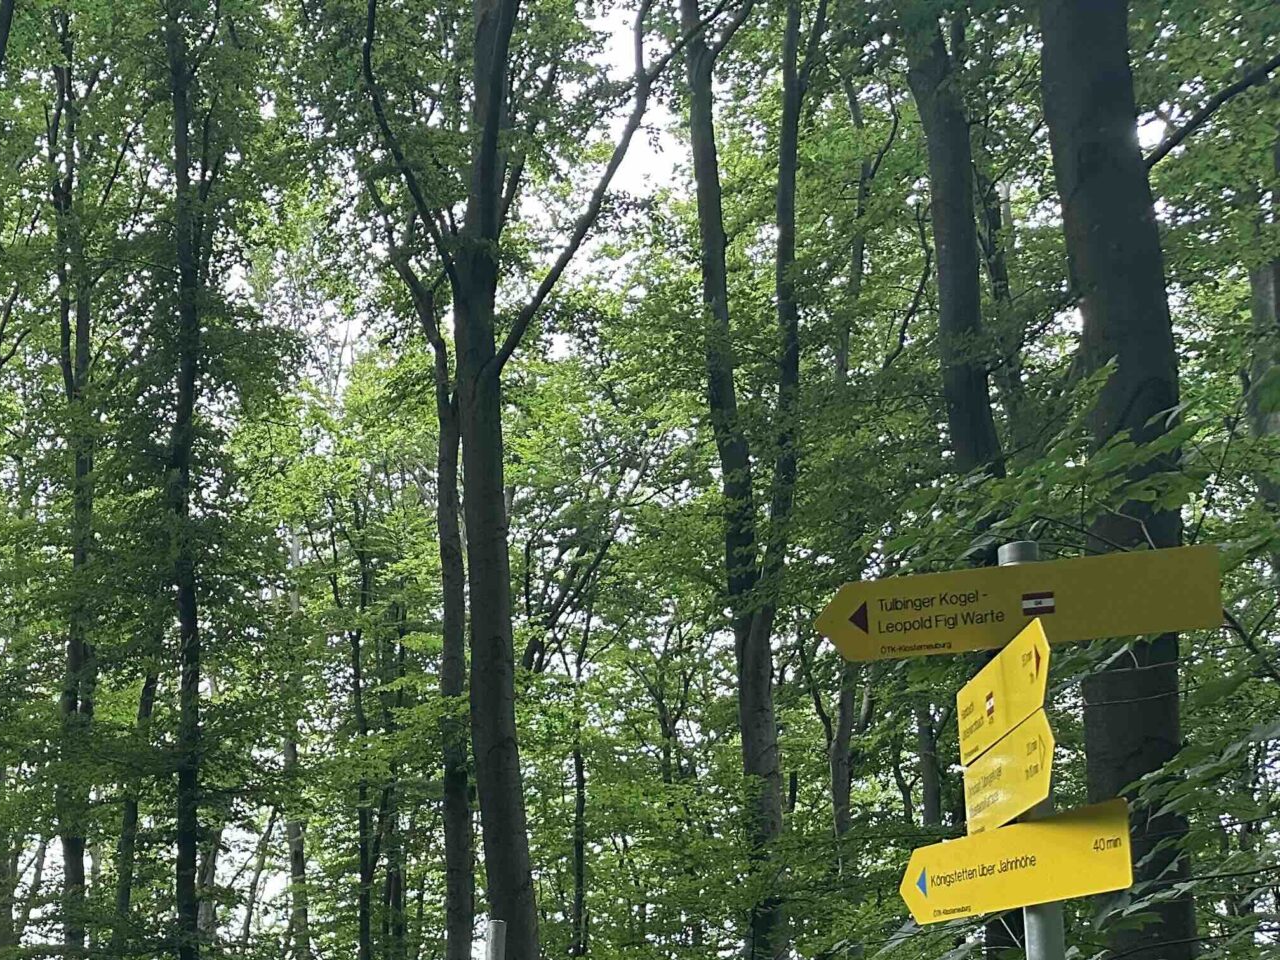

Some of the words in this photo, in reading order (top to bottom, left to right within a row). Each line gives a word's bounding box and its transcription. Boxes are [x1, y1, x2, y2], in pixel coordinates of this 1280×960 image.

[878, 595, 935, 611] Tulbinger
[939, 590, 979, 606] Kogel
[878, 616, 932, 634] Leopold
[935, 613, 958, 630] Figl
[961, 610, 1005, 625] Warte
[1093, 838, 1106, 852] 40
[1106, 836, 1122, 849] min
[930, 866, 978, 887] Königstetten
[997, 854, 1036, 874] Jahnhöhe
